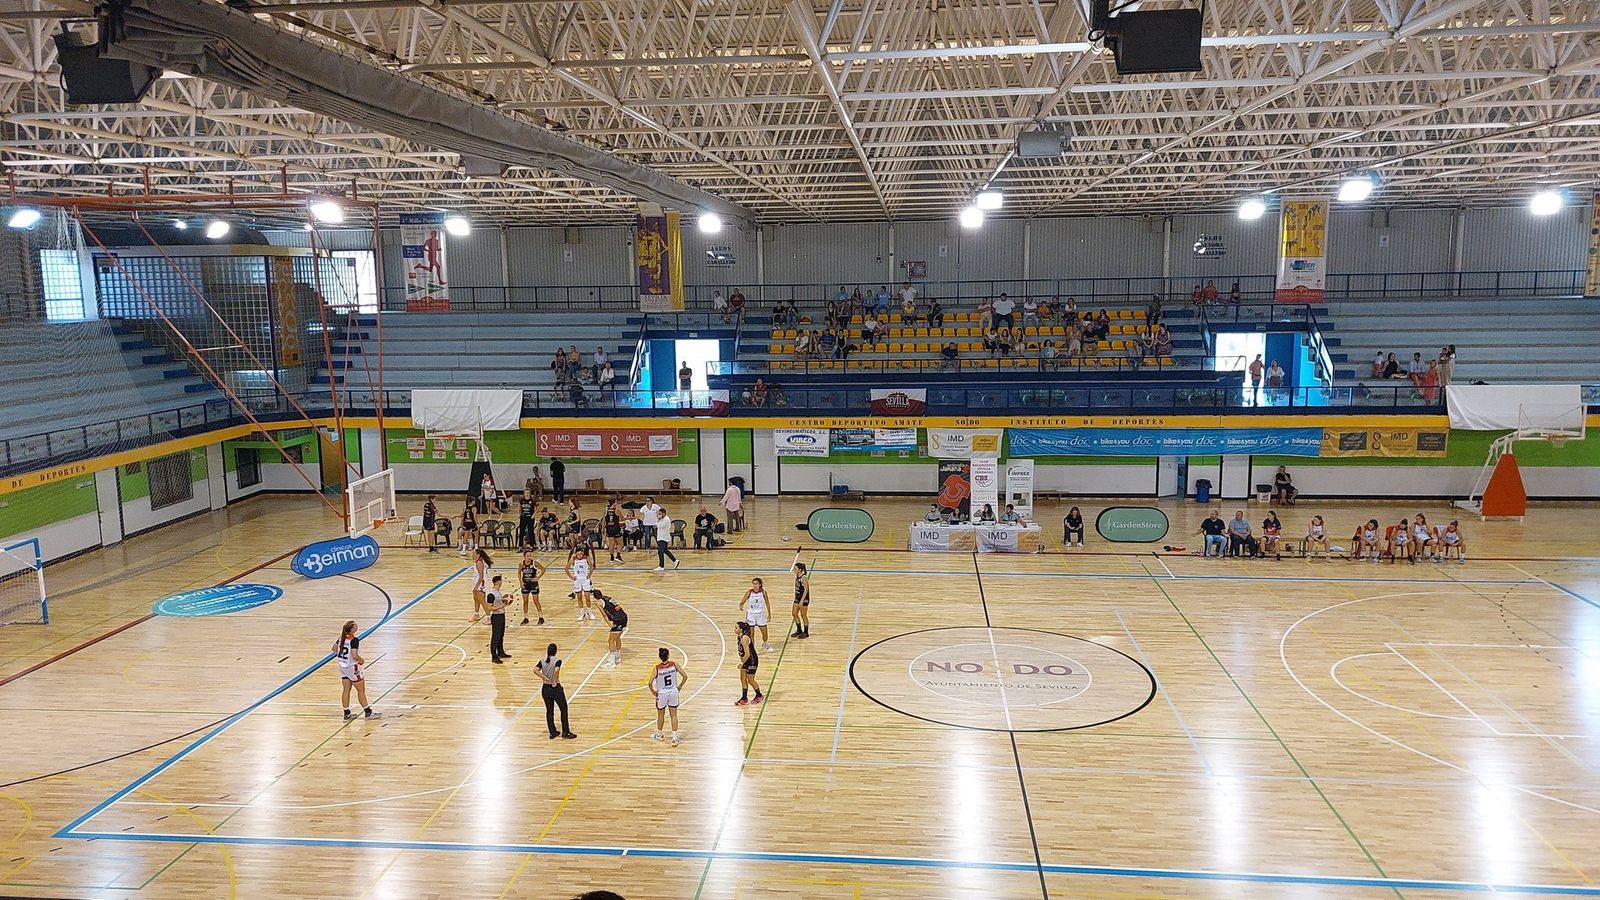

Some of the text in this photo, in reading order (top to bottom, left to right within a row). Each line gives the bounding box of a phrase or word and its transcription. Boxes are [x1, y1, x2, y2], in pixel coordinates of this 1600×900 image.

[886, 397, 910, 407] SEVILLA
[1070, 436, 1090, 445] doc
[1101, 438, 1130, 446] bike&you
[1133, 435, 1154, 445] doc
[1163, 437, 1193, 446] bike&you
[1196, 435, 1217, 445] doc
[1227, 437, 1258, 446] bike&you
[1260, 434, 1281, 444] doc
[1391, 432, 1408, 440] IMD
[11, 465, 86, 488] DE DEPORTES
[822, 521, 868, 530] GardenStore
[920, 532, 940, 540] IMD
[988, 532, 1008, 540] IMD
[926, 661, 1073, 676] NO DO
[664, 675, 672, 686] 6
